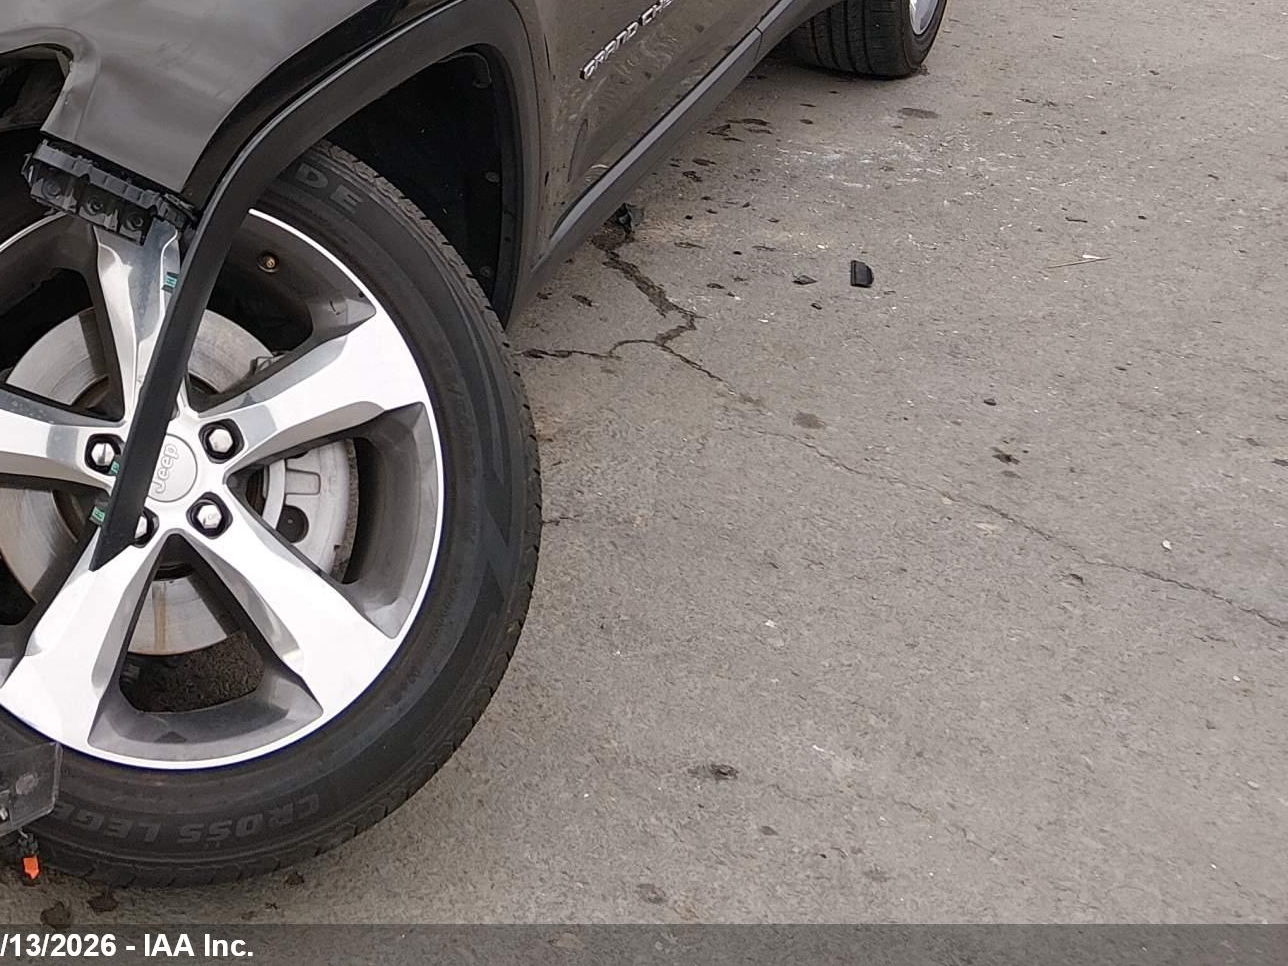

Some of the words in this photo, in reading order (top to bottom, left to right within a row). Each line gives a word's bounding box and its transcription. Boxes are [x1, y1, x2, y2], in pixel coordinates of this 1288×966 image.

[582, 20, 640, 81] GRAND
[152, 443, 179, 495] Jeep
[52, 802, 162, 844] LEGE
[177, 793, 320, 845] CROSS
